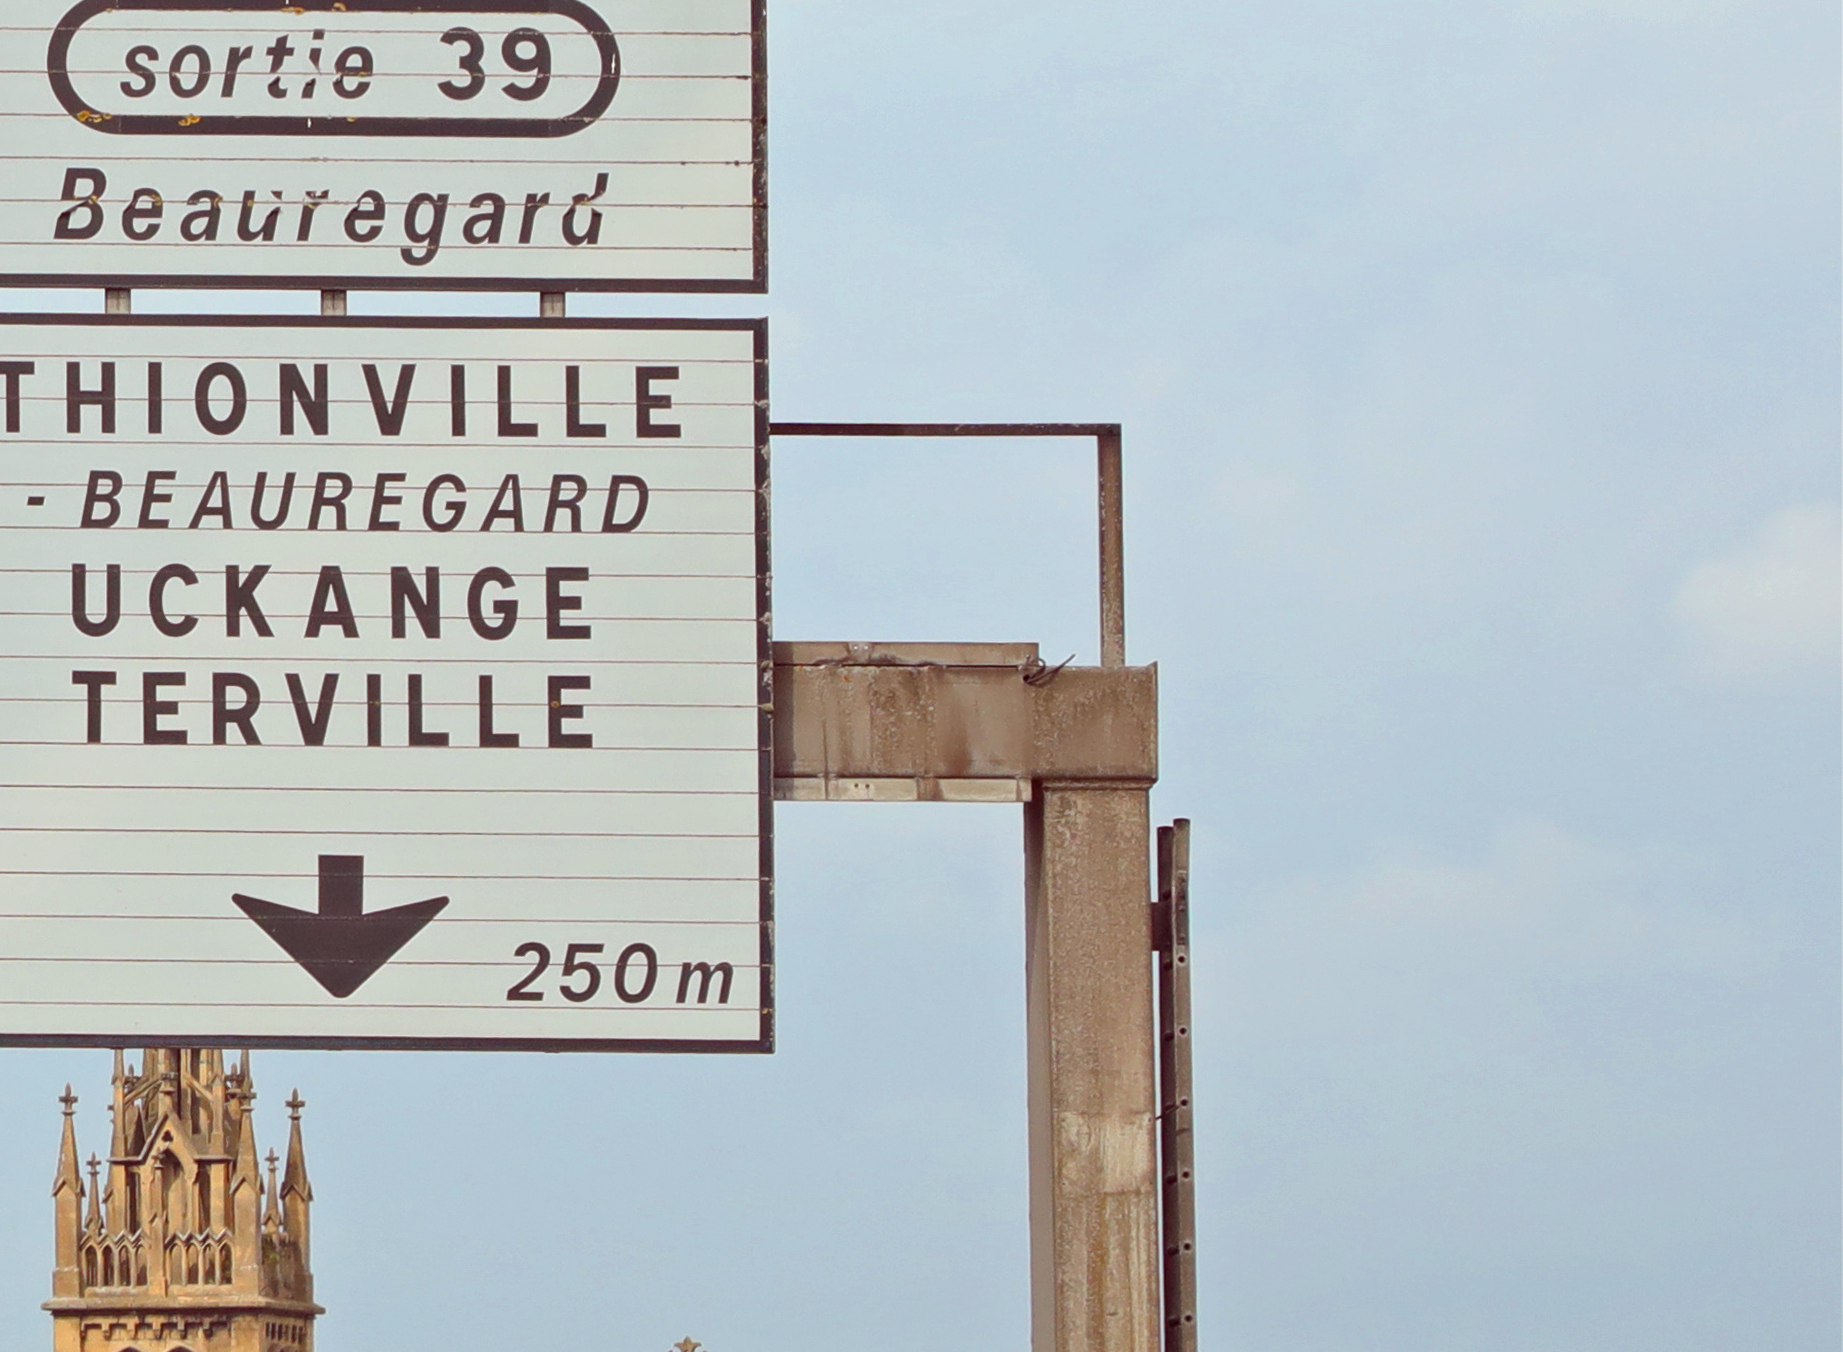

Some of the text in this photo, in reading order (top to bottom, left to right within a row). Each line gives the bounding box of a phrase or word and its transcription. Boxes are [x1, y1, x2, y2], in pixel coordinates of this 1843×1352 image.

[119, 25, 553, 103] sortie 39
[52, 166, 610, 267] Beauregard
[78, 469, 650, 535] BEAUREGARD
[70, 562, 593, 642] UCKANGE
[71, 669, 594, 750] TERVILLE
